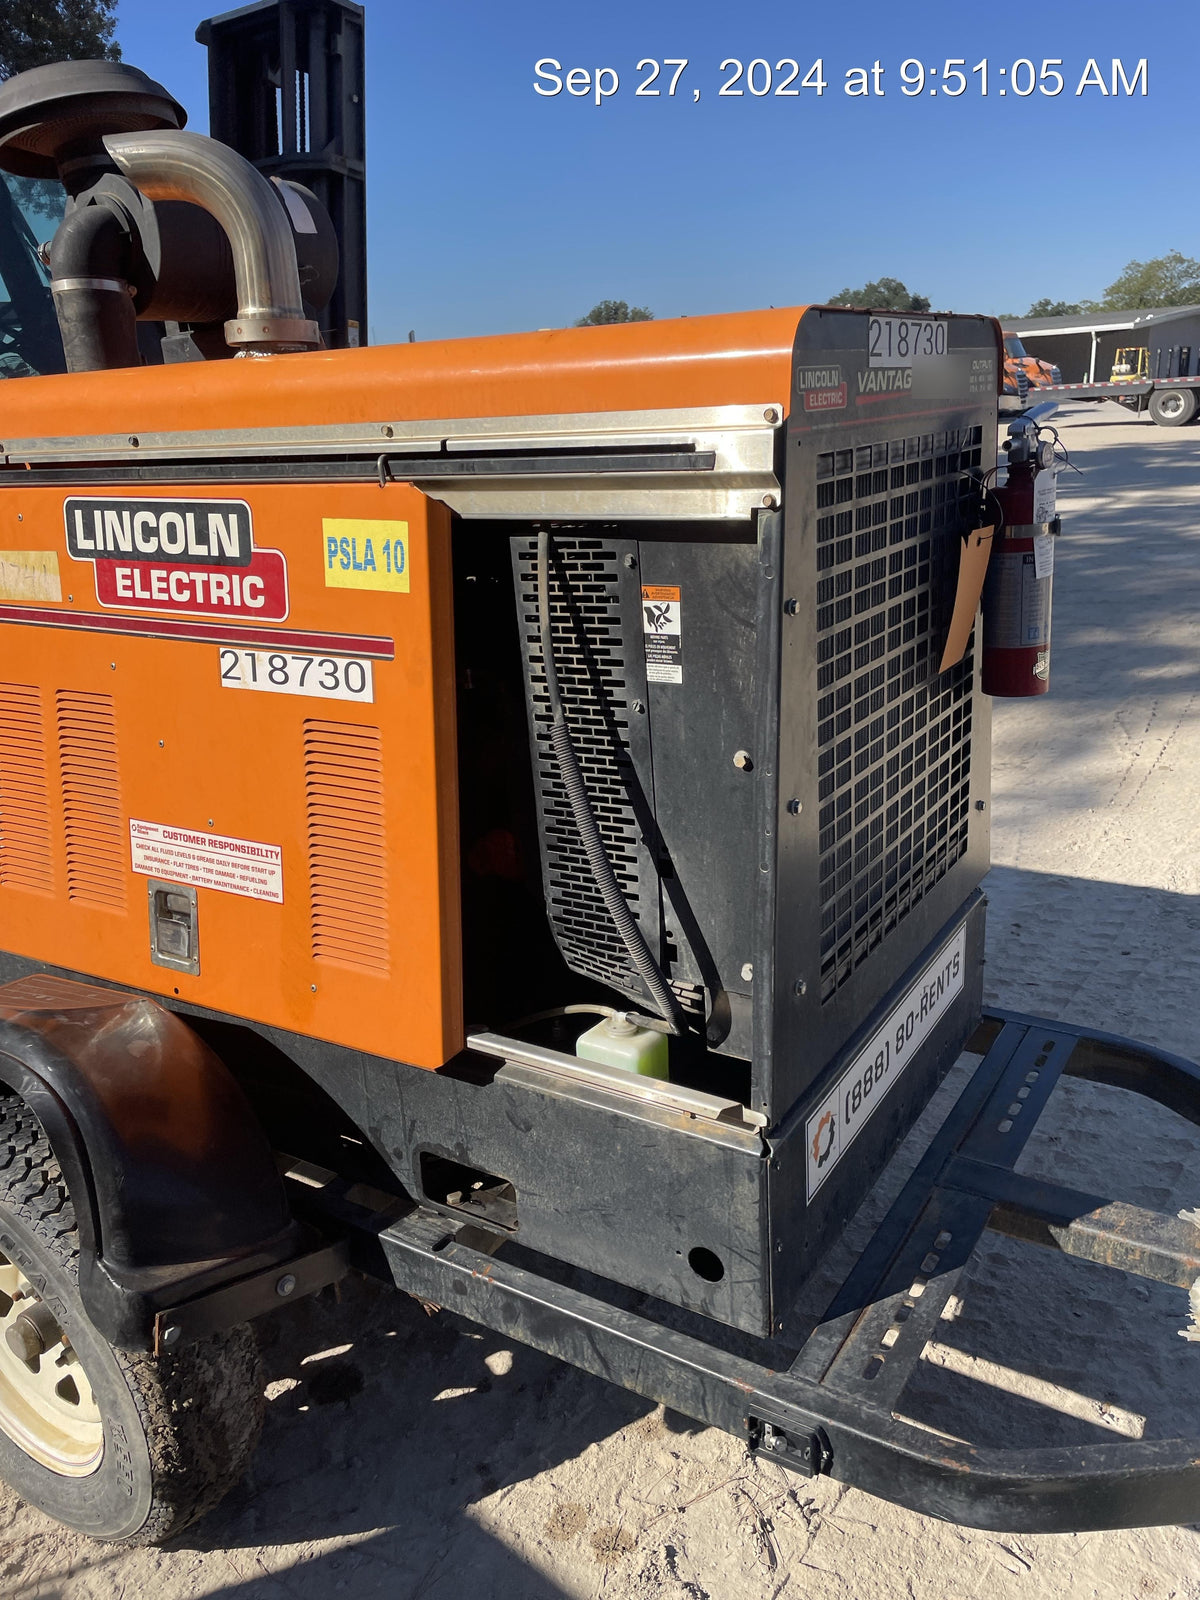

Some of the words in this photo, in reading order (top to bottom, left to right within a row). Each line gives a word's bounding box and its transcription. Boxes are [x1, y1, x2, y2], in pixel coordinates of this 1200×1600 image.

[869, 319, 945, 358] 218730
[800, 370, 839, 389] LINCOLN
[857, 369, 913, 393] VANTAG
[809, 392, 843, 407] ELECTRIC
[74, 509, 240, 558] LINCOLN
[327, 536, 377, 572] PSLA
[382, 538, 405, 574] 10
[115, 567, 265, 608] ELECTRIC
[220, 650, 366, 693] 218730
[136, 843, 150, 851] CHECK
[160, 848, 174, 856] FLUID
[174, 851, 191, 859] LEVELS
[196, 856, 215, 864] GREASE
[216, 858, 230, 867] DAILY
[231, 862, 250, 871] BEFORE
[251, 866, 267, 875] START
[162, 830, 207, 846] CUSTOMER
[208, 838, 280, 860] RESPONSIBILITY
[134, 863, 154, 872] DAMAGE
[161, 868, 189, 879] EQUIPMENT
[192, 875, 213, 884] BATTERY
[213, 880, 250, 893] MAINTENANCE
[253, 888, 279, 899] CLEANING
[144, 855, 170, 866] INSURANCE
[185, 863, 200, 871] TIRES
[202, 867, 214, 875] TIRE
[215, 869, 236, 879] DAMAGE
[240, 875, 268, 885] REFUELING
[845, 1040, 890, 1125] (888)
[895, 951, 960, 1055] 80-RENTS
